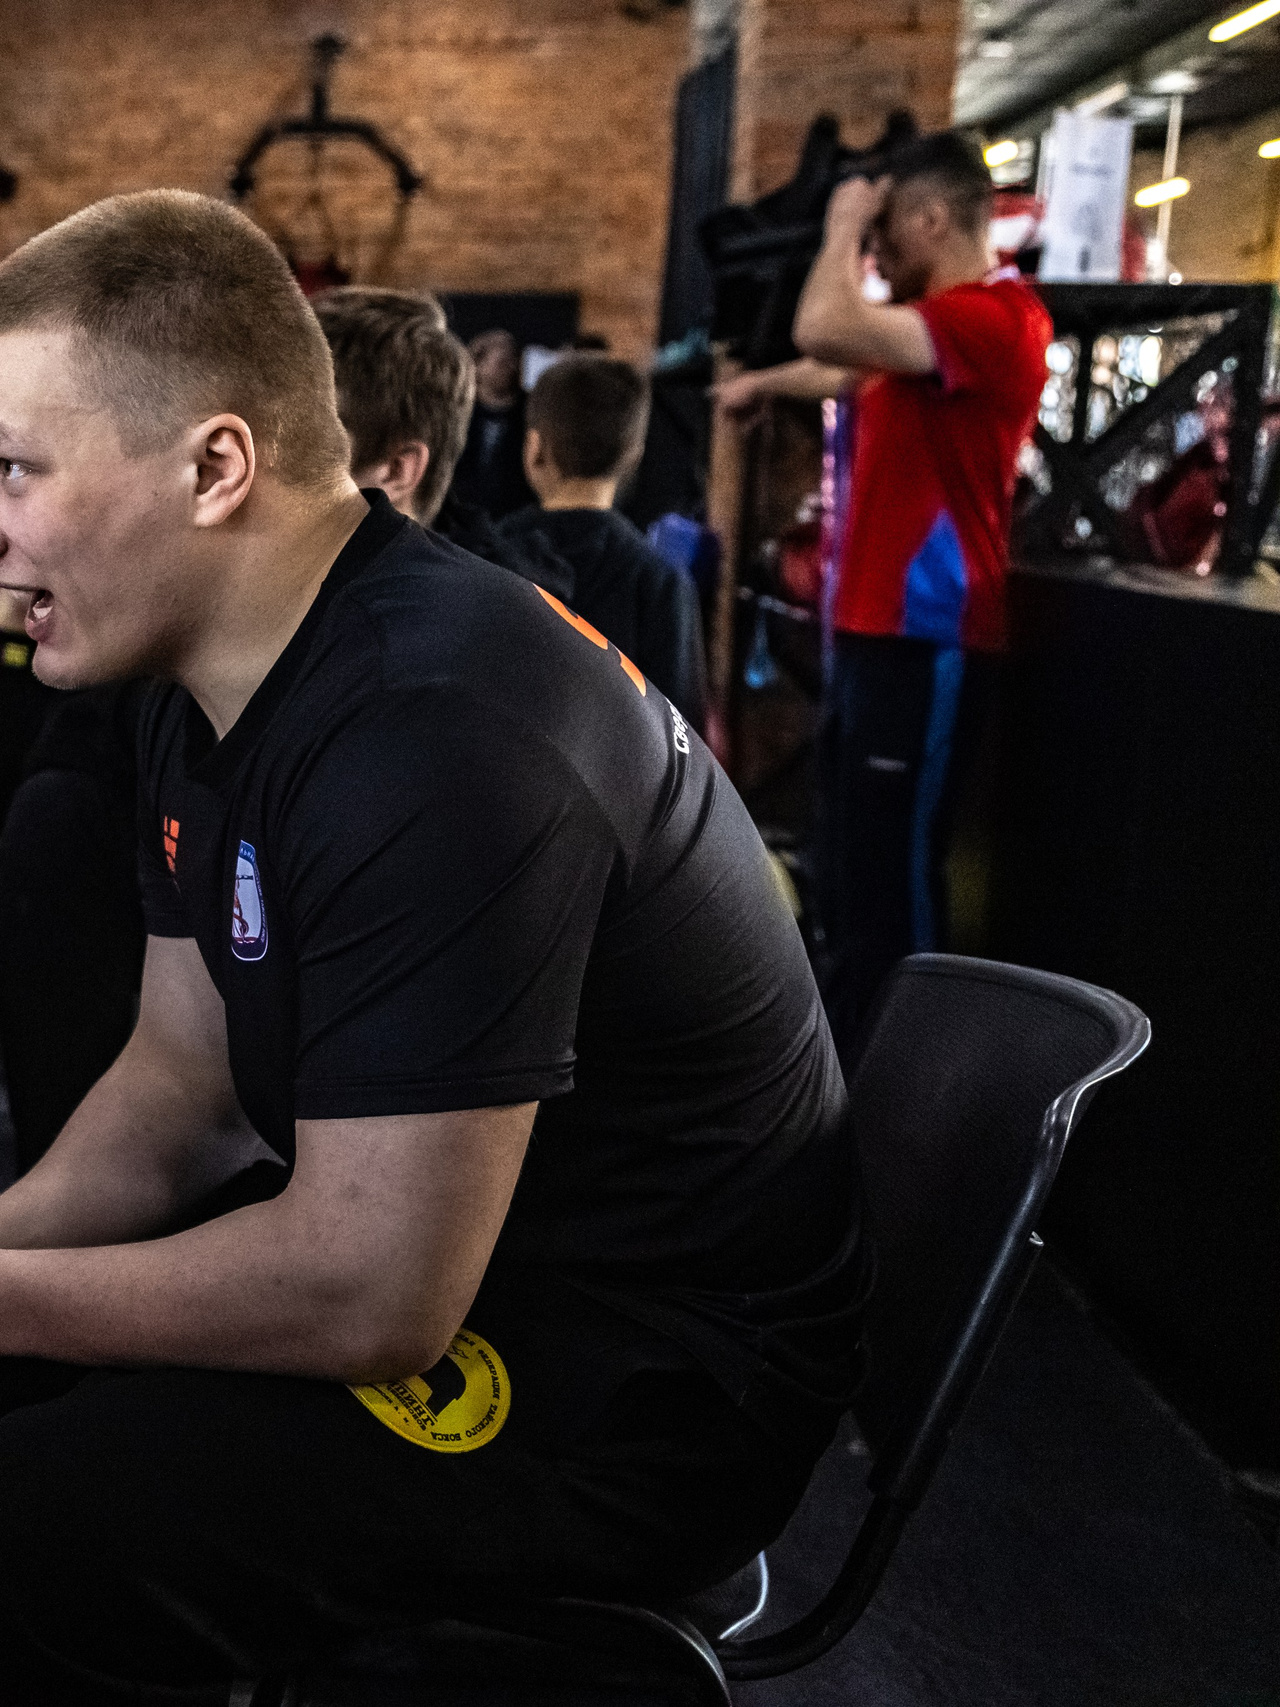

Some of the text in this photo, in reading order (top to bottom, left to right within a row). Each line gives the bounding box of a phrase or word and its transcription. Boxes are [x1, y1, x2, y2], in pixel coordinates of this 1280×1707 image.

[665, 697, 690, 754] Свер
[430, 1349, 500, 1442] ФЕДЕРАЦИЯ ТАЙСКОГО БОКСА
